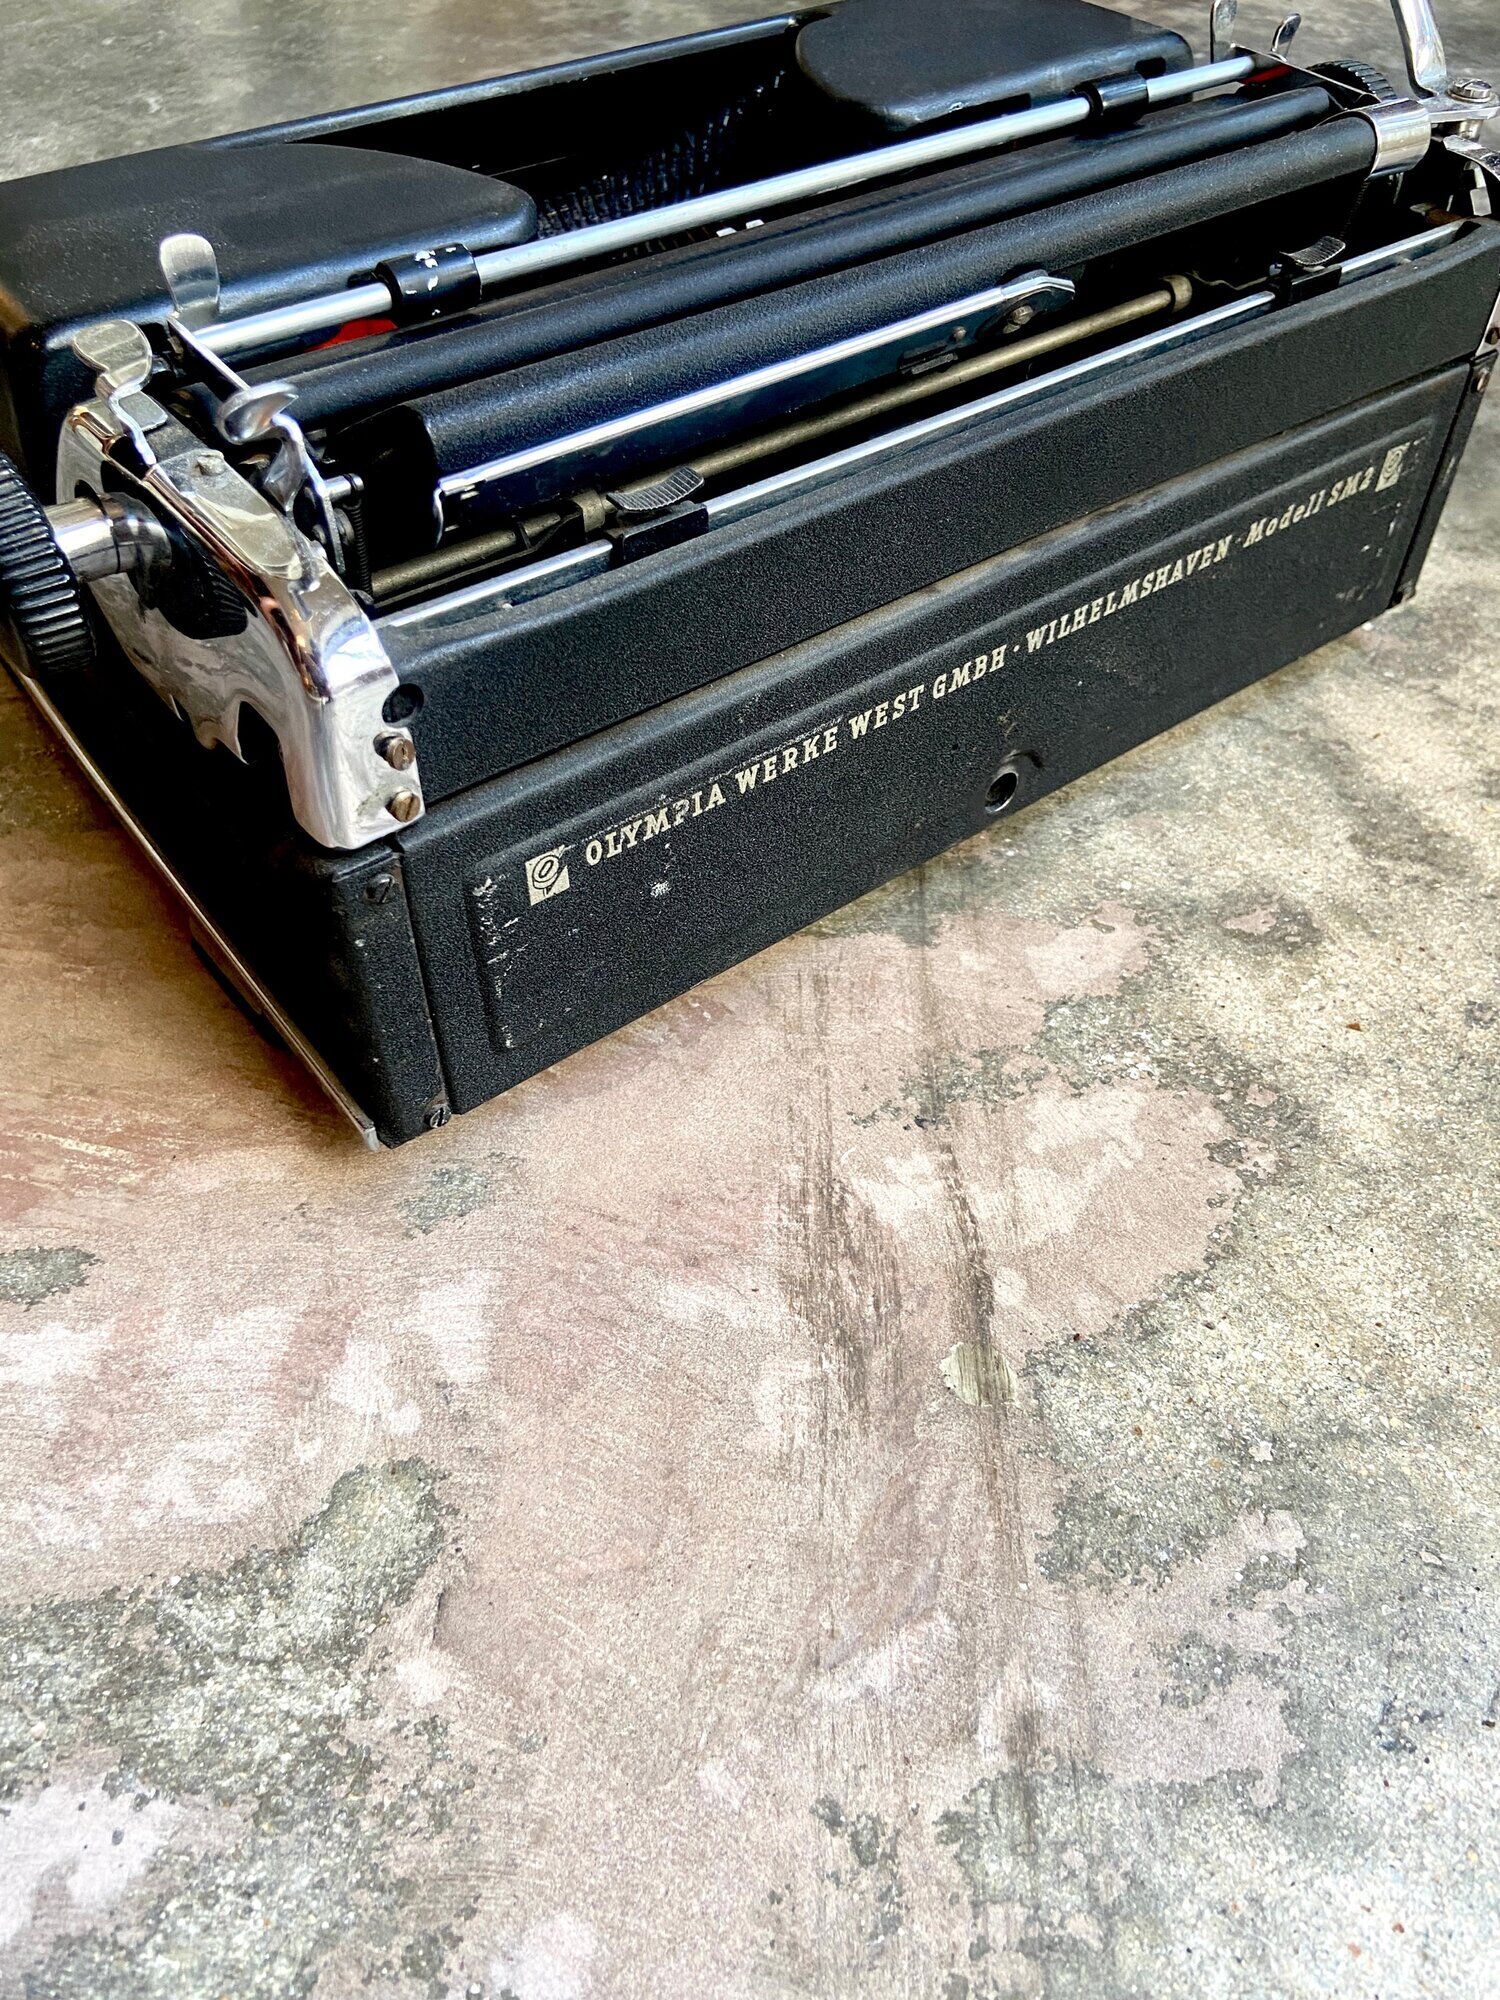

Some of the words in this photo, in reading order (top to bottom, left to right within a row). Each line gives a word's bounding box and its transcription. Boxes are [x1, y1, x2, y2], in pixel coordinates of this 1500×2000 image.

[585, 783, 726, 866] OLYMPIA
[735, 725, 839, 794] WERKE
[848, 684, 925, 740] WEST
[932, 644, 1007, 700] GMBH
[1025, 534, 1233, 653] WILHELMSHAVEN
[1242, 489, 1326, 548] Modell
